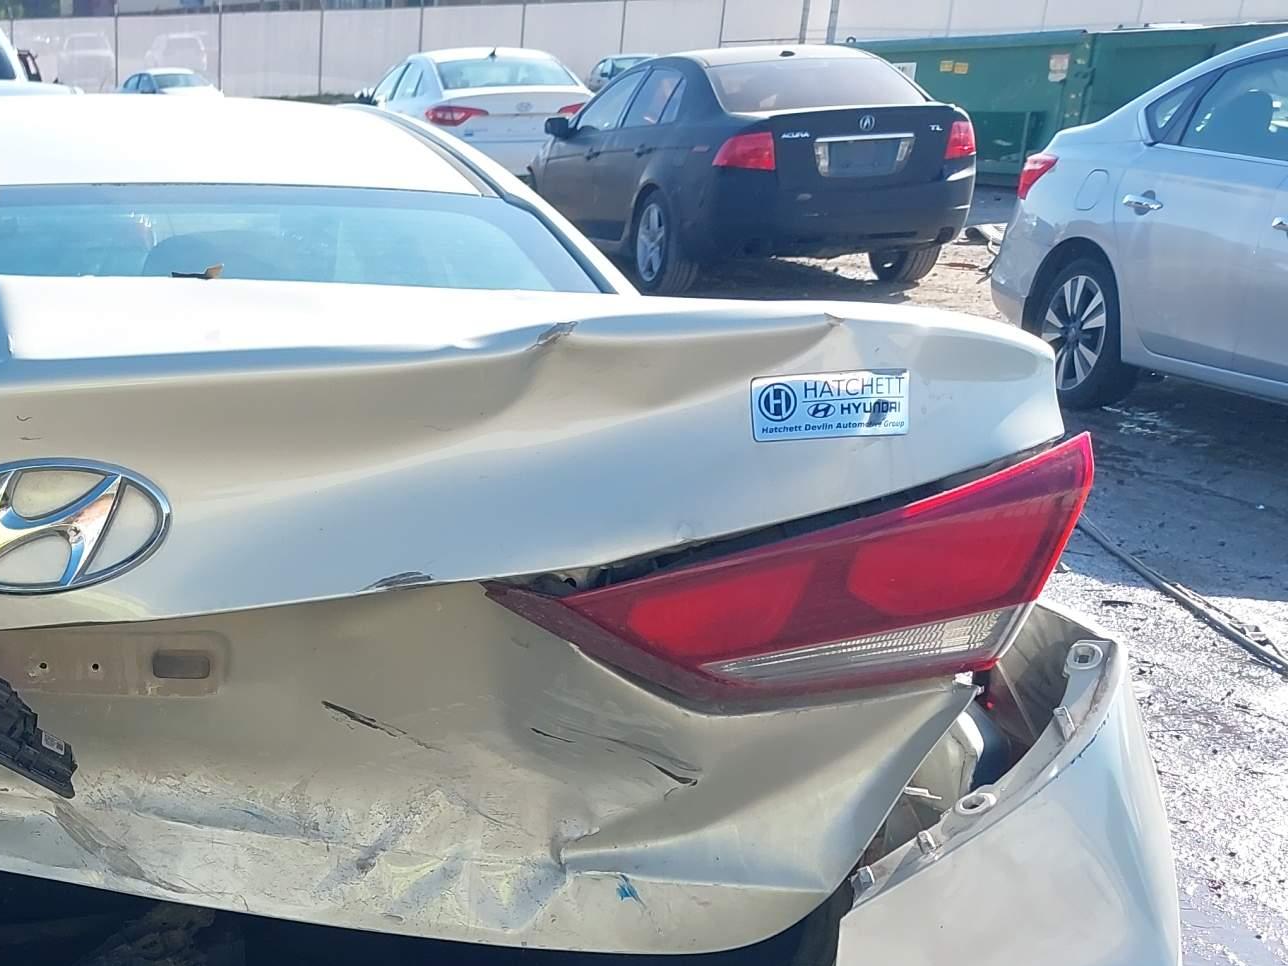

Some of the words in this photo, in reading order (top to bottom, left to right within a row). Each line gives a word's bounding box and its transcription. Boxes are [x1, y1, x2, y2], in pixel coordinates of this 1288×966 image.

[804, 377, 904, 398] HATCHETT
[841, 401, 900, 415] HYUNDAI
[762, 425, 802, 435] Hatchett
[804, 422, 833, 432] Devlin
